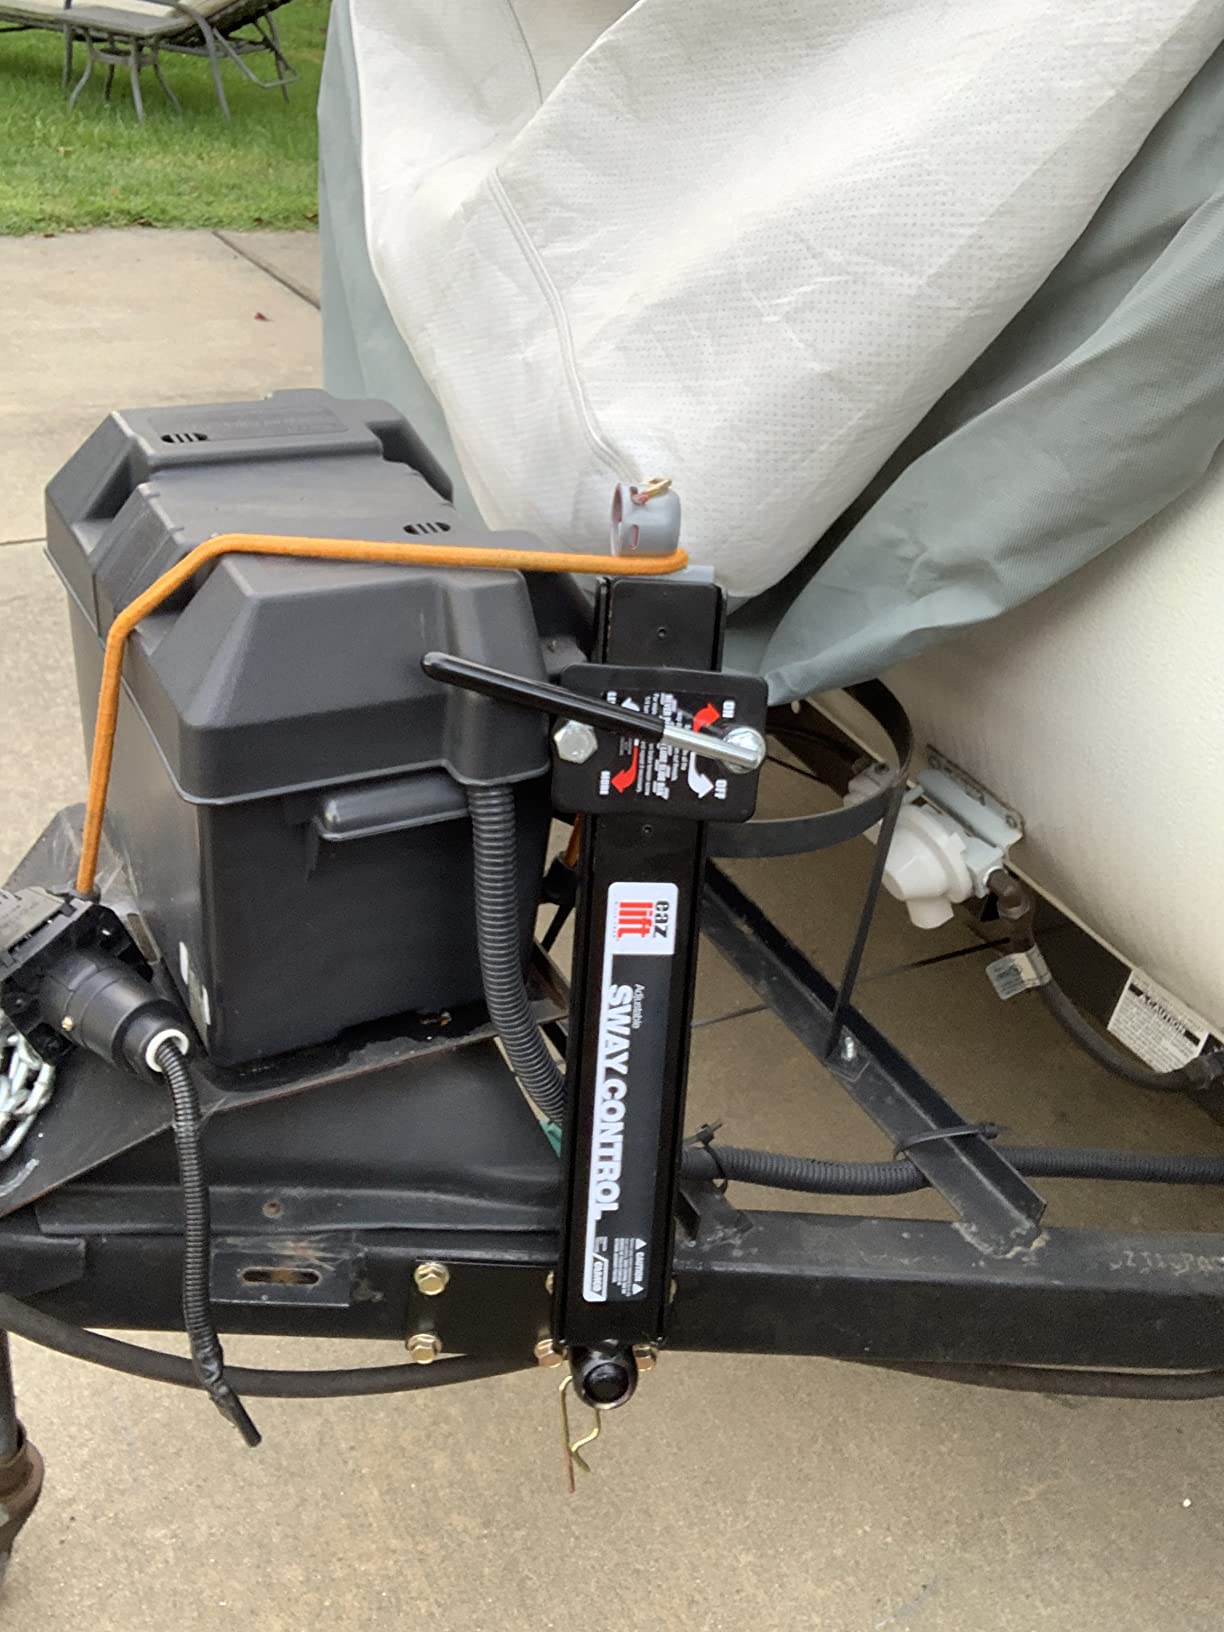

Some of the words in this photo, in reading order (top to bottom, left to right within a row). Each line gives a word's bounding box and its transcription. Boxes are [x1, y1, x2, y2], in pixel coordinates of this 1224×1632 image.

[722, 700, 735, 718] ON
[599, 770, 611, 795] MORE
[714, 779, 727, 799] OFF
[617, 902, 653, 938] lift
[653, 901, 670, 938] eaz
[631, 983, 645, 1029] Adjustable
[1147, 998, 1187, 1034] CAUTION
[604, 984, 634, 1075] SWAY
[595, 1078, 628, 1220] CONTROL
[634, 1252, 645, 1282] CAUTION
